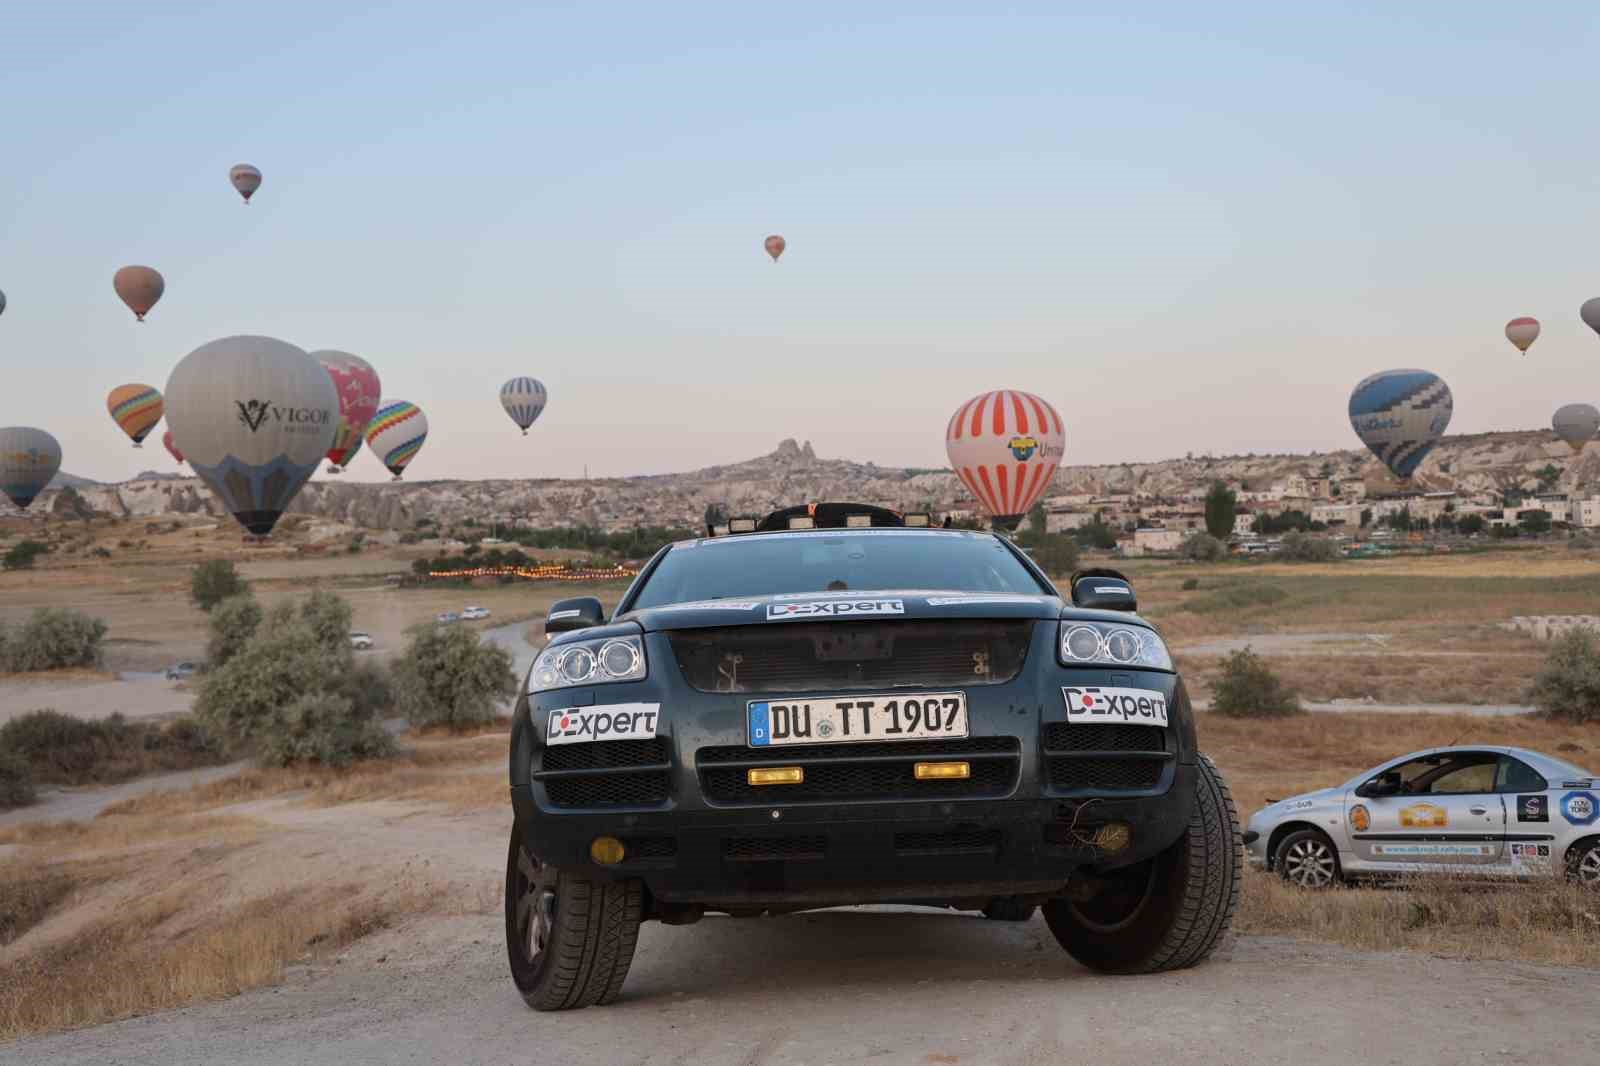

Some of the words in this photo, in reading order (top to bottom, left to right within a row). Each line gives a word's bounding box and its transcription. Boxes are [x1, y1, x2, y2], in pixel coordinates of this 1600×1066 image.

[769, 600, 903, 618] DExpert
[771, 704, 812, 740] DU
[835, 701, 875, 735] TT
[883, 697, 960, 734] 1907
[1063, 687, 1167, 721] DExpert
[547, 708, 657, 740] DExpert
[755, 728, 764, 738] D
